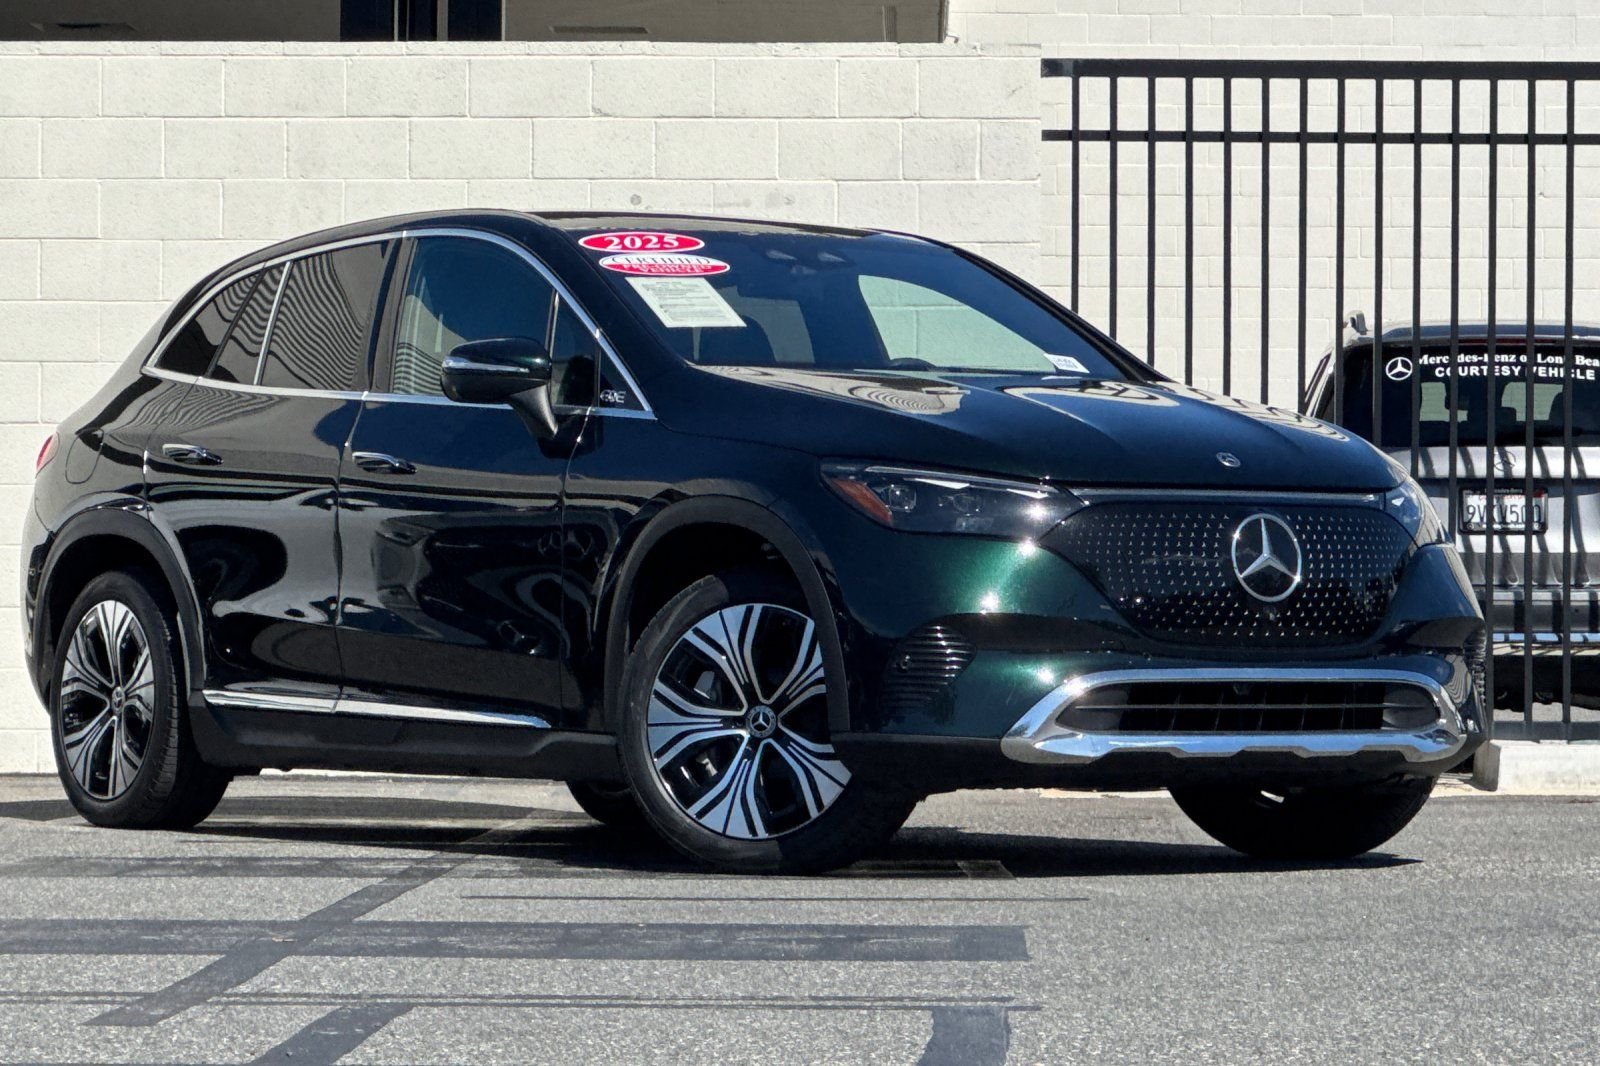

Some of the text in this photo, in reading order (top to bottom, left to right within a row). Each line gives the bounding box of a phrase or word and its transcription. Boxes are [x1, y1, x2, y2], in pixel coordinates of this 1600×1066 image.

[604, 235, 680, 249] 2025
[1418, 353, 1517, 365] Mercdes-enz
[1536, 353, 1566, 365] Lon
[1530, 366, 1596, 380] EHILE
